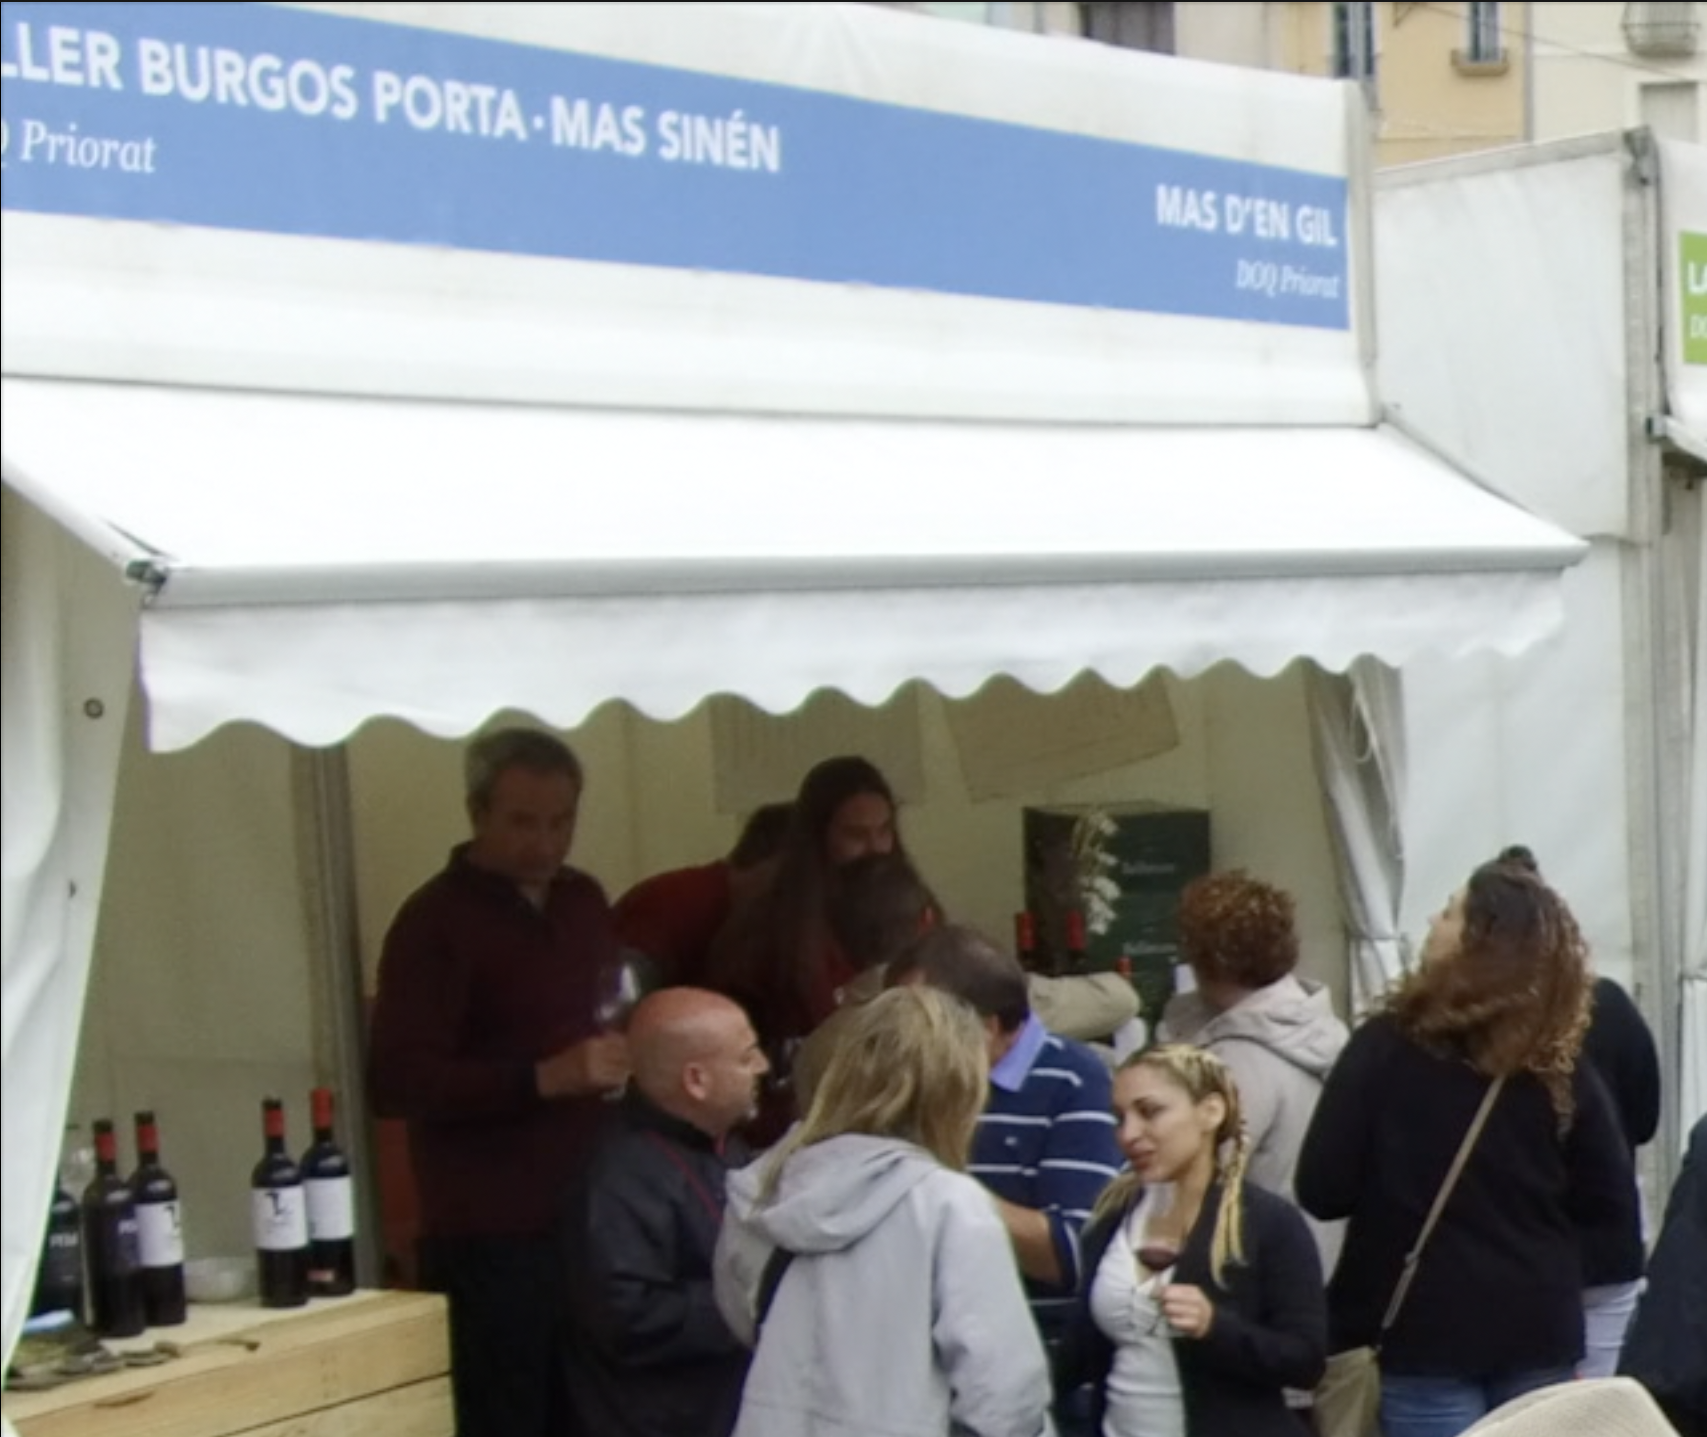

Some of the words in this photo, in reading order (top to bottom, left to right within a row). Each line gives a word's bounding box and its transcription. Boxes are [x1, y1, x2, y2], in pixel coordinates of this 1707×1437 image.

[137, 37, 358, 120] BURGOS
[657, 108, 781, 173] SINÉN
[20, 118, 157, 174] Priorat
[1156, 183, 1218, 232] MAS
[1224, 193, 1290, 241] D'EN
[1296, 204, 1339, 248] GIL
[1236, 258, 1277, 298] DOQ
[1280, 264, 1340, 299] Priorat
